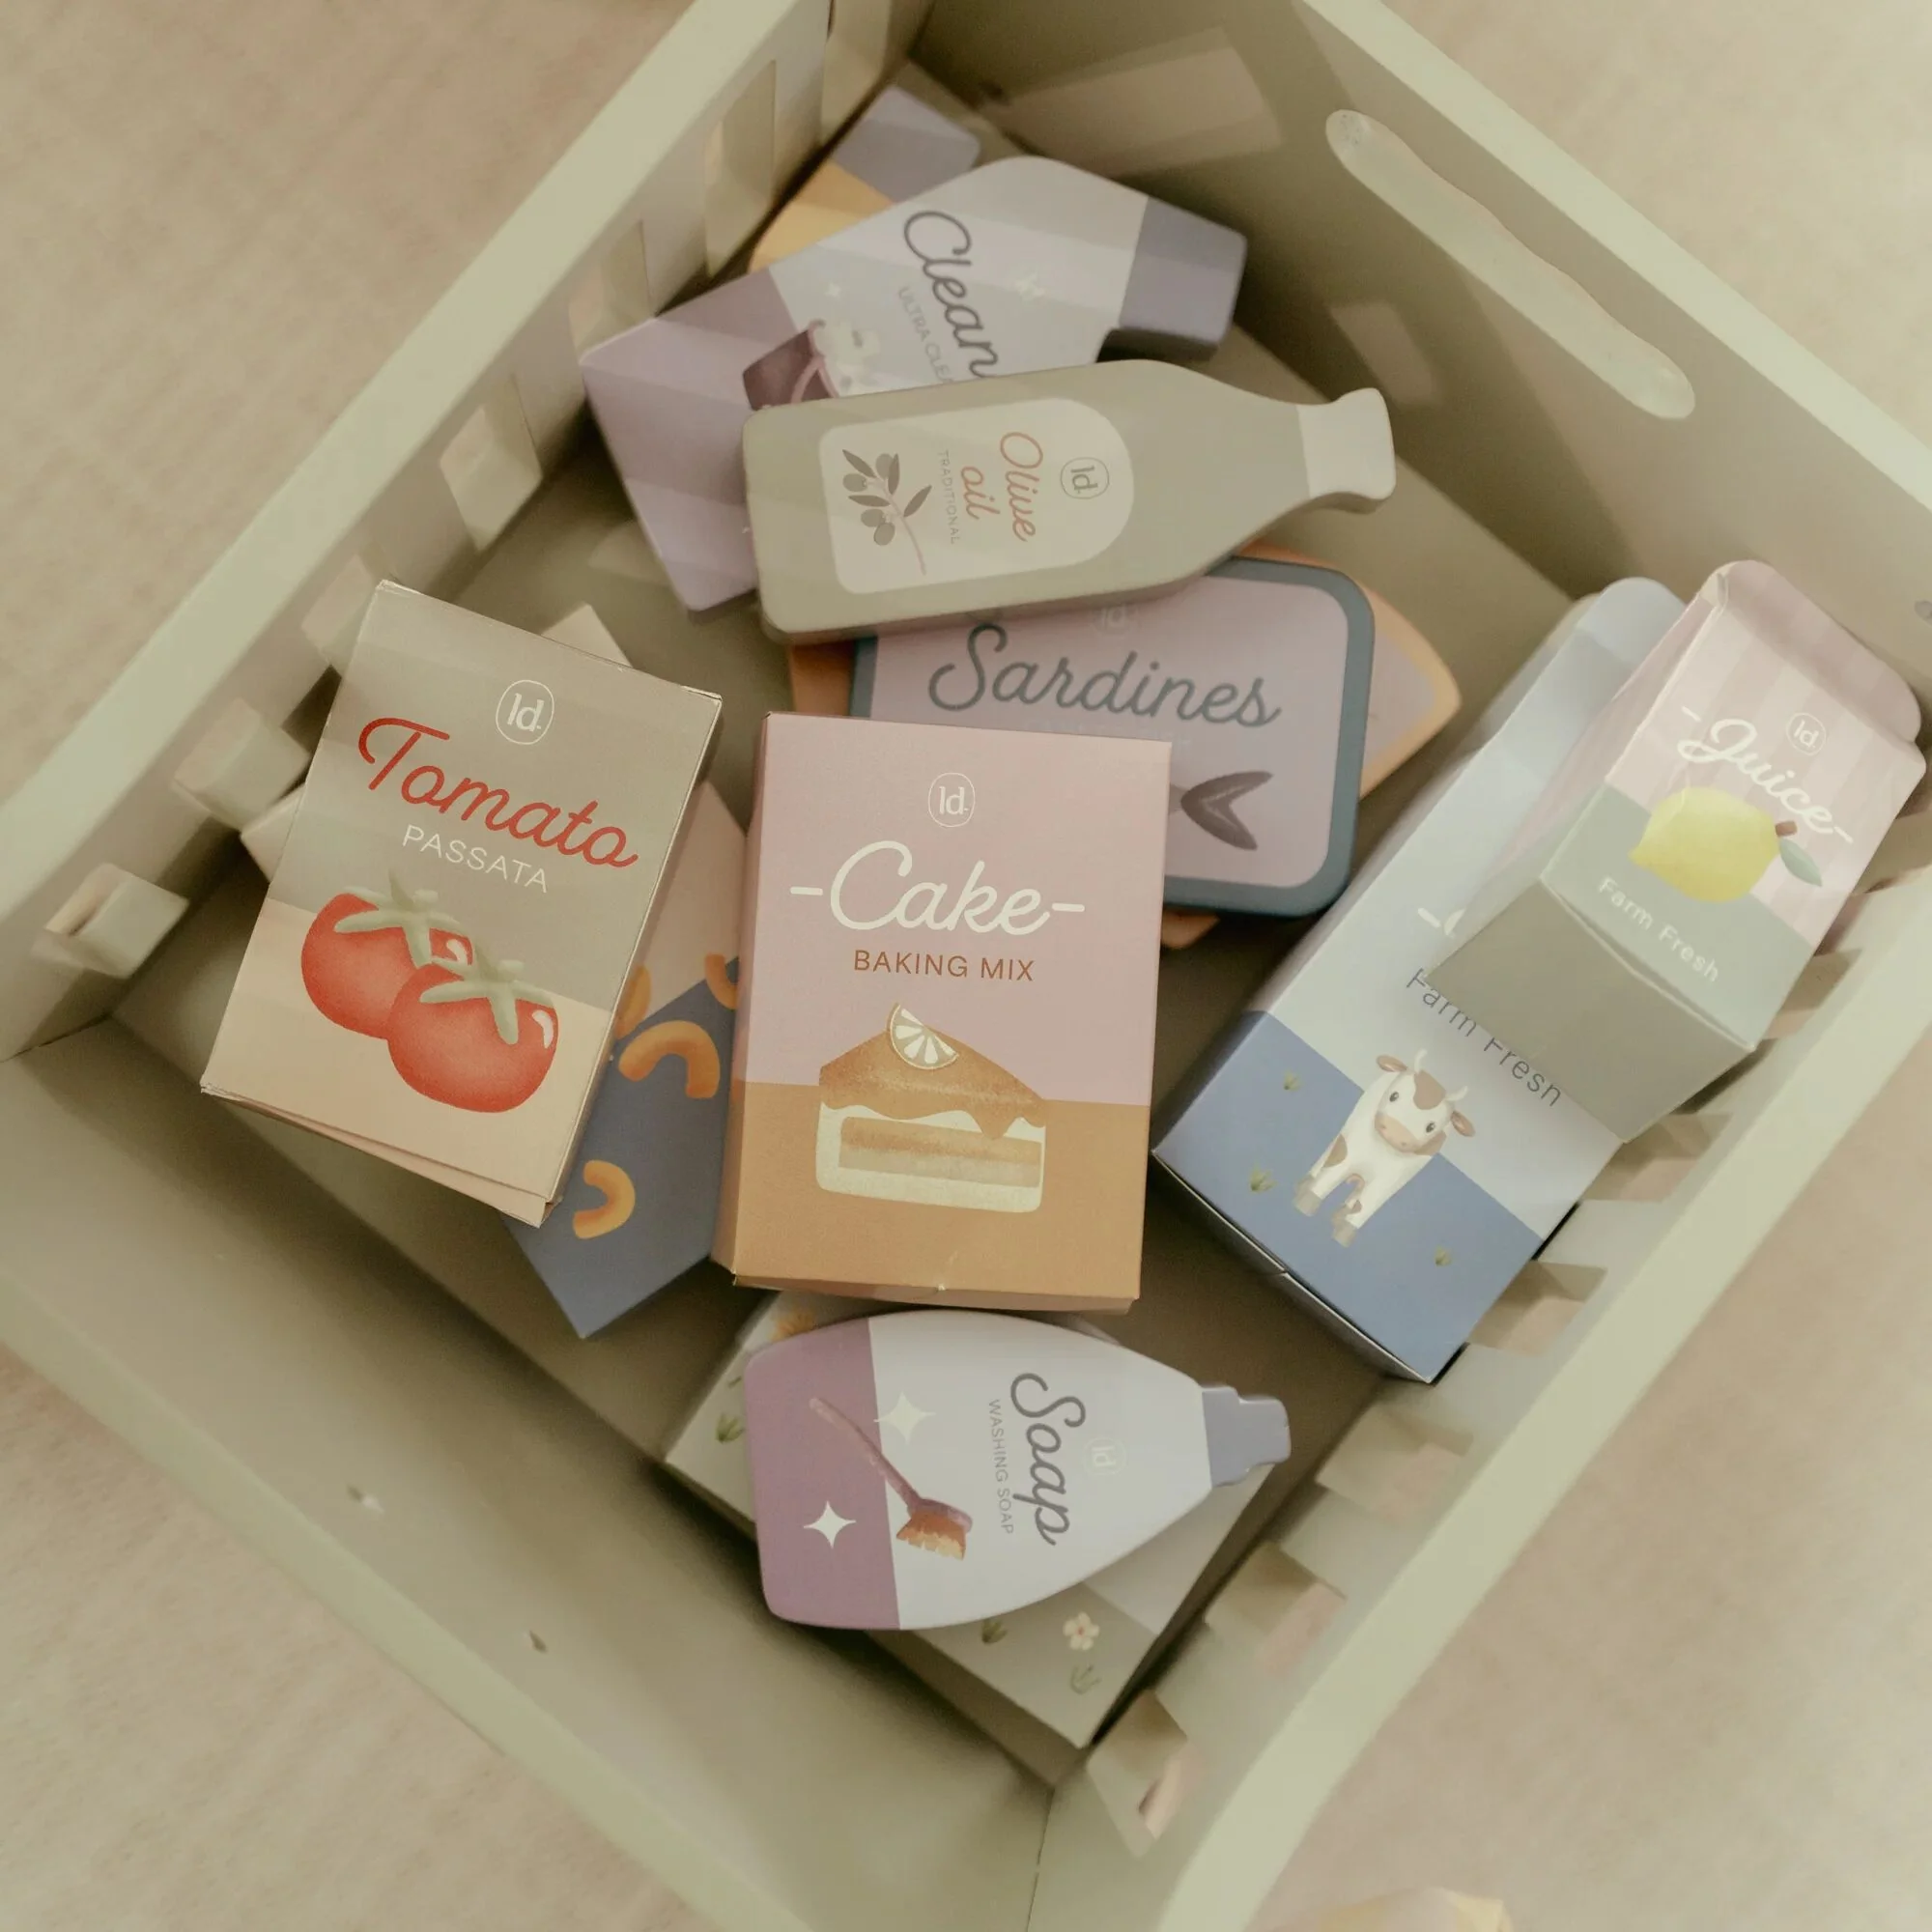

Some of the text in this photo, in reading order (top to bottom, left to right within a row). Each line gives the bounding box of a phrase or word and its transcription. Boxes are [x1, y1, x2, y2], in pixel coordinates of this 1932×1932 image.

[897, 284, 932, 342] ULTRA
[902, 209, 999, 378] Clean
[936, 448, 959, 544] TRADITIONAL
[959, 465, 1001, 521] oil
[999, 431, 1043, 543] Olive
[928, 622, 1282, 727] Sardines
[358, 717, 639, 867] Tomato
[402, 824, 548, 893] PASSATA
[854, 950, 1035, 981] BAKING MIX
[1599, 874, 1719, 982] Farm Fresh
[988, 1399, 1014, 1535] WASHING SOAP
[1009, 1372, 1086, 1547] Soap
